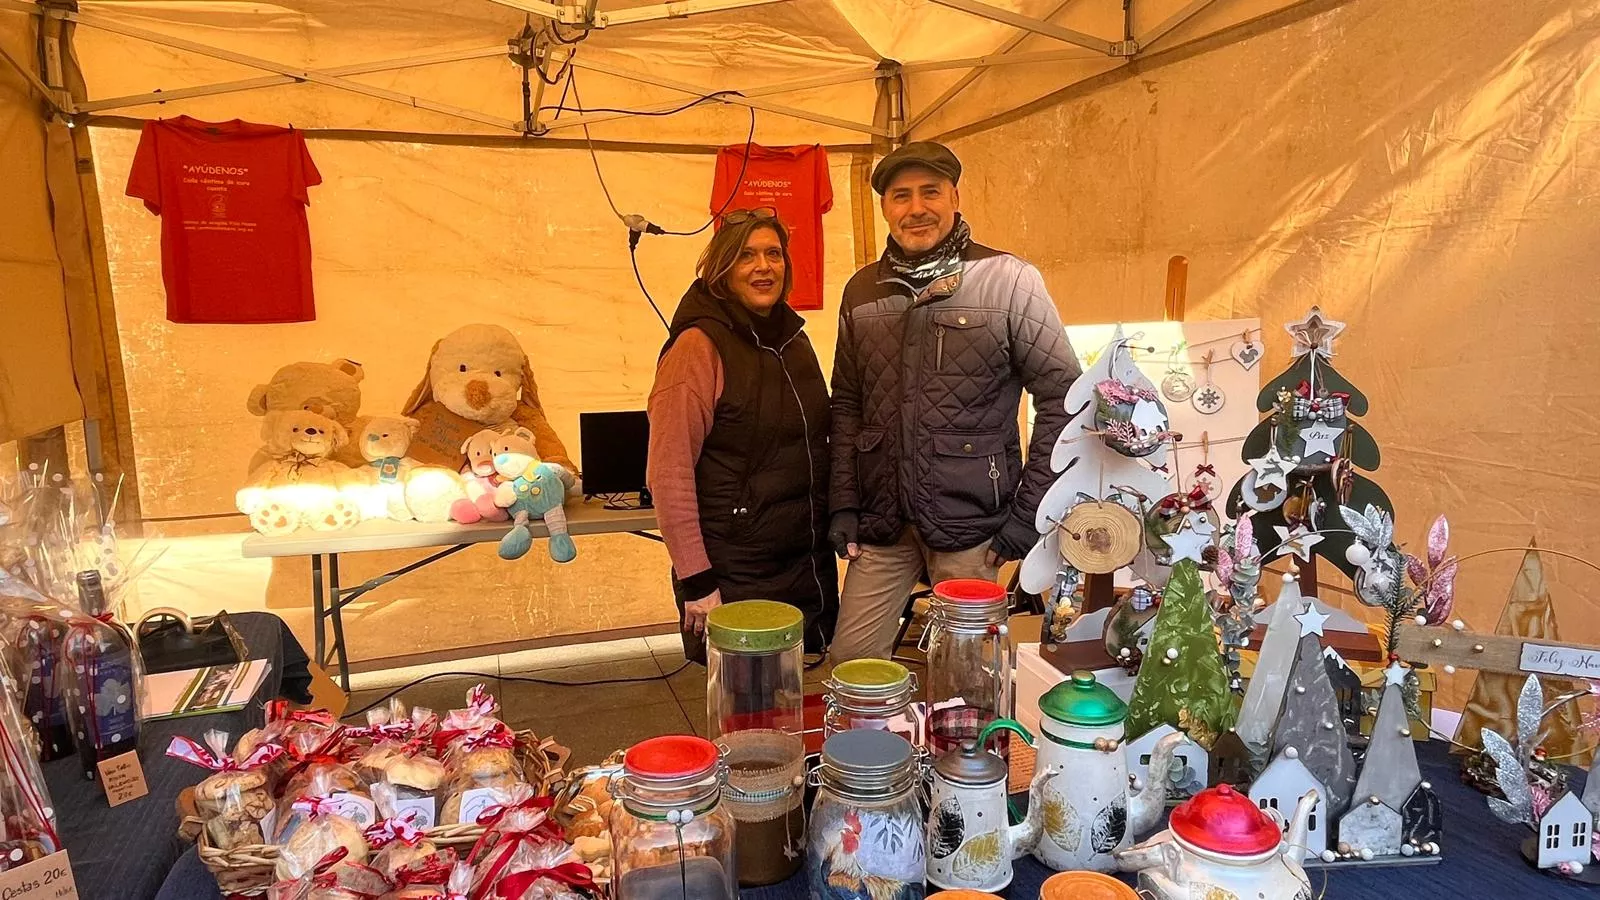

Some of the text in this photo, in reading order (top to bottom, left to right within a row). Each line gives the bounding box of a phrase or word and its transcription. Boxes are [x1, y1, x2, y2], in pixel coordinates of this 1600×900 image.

[1309, 431, 1329, 440] Paz
[1530, 651, 1563, 672] Feliz
[2, 880, 40, 900] Cestas
[43, 867, 67, 885] 20€
